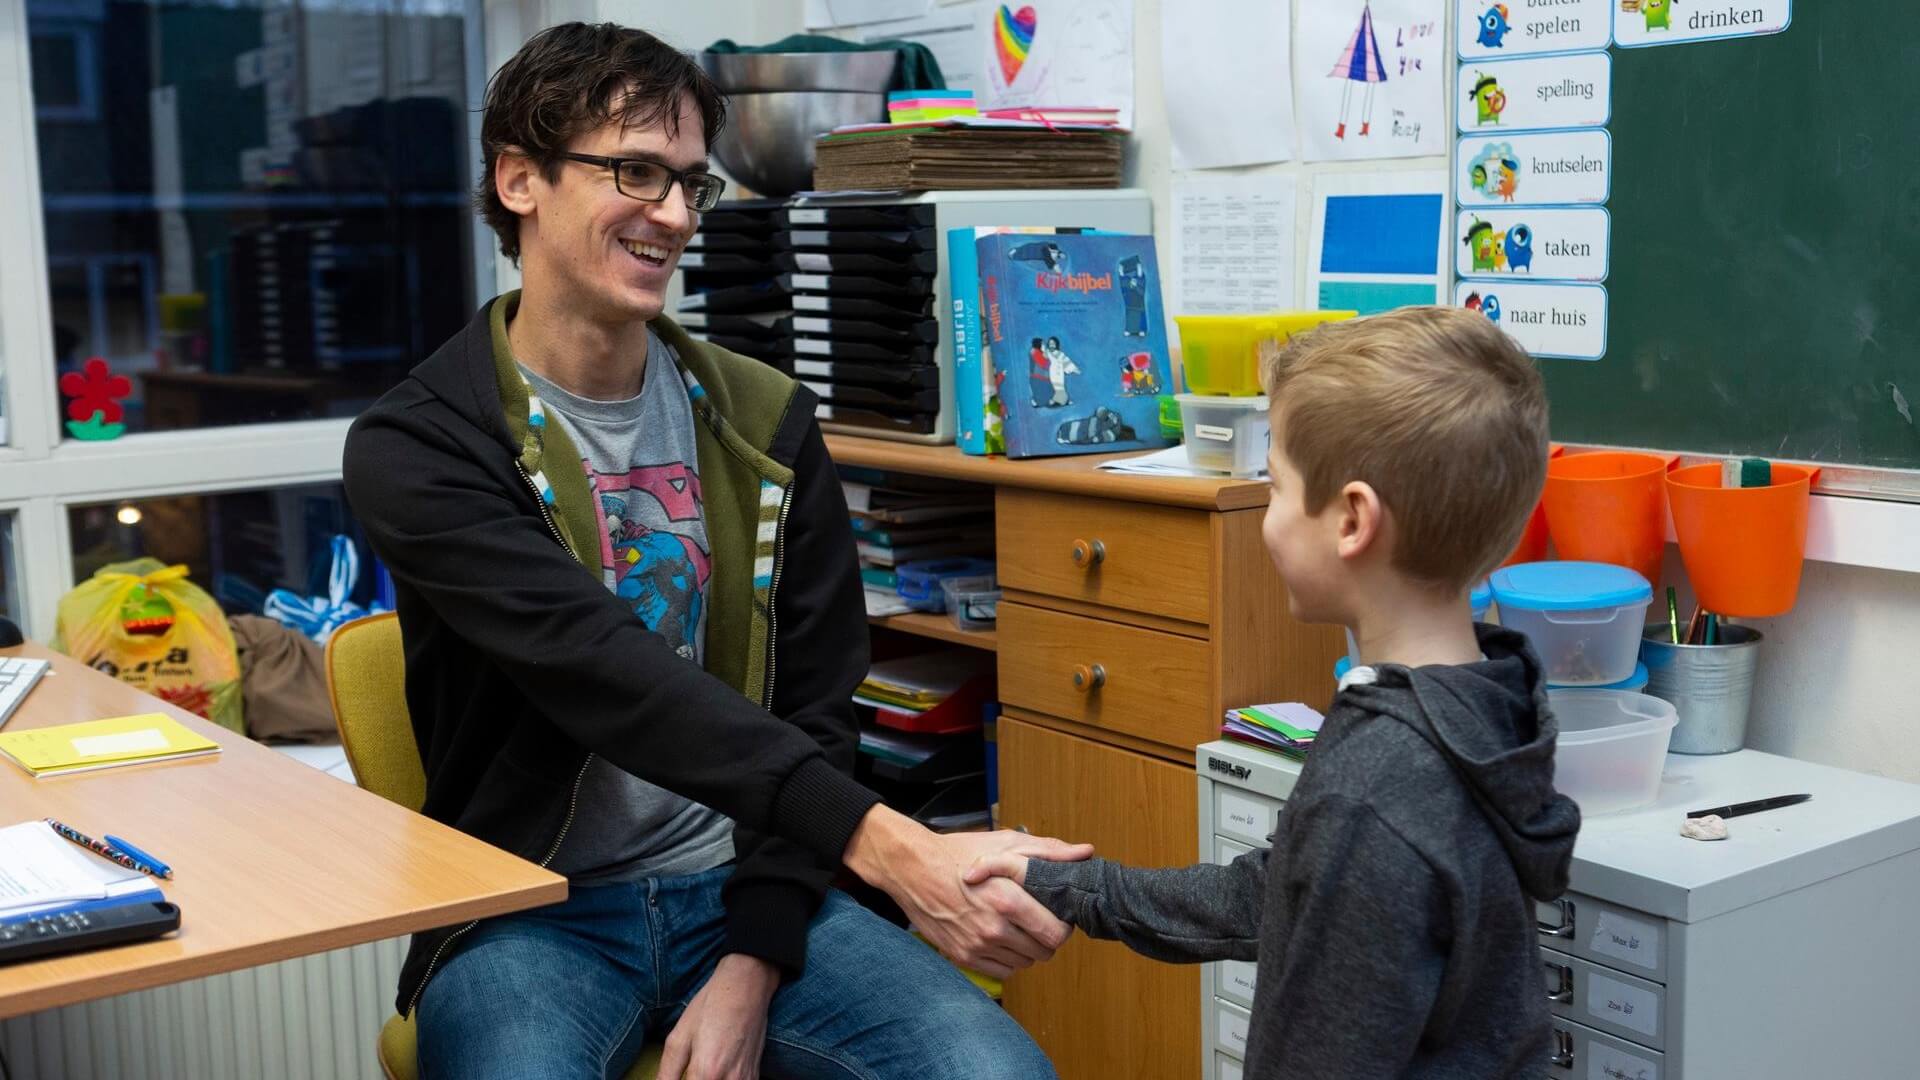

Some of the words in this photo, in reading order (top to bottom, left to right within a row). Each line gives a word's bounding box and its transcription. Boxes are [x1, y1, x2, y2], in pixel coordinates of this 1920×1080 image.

[1526, 16, 1581, 38] spelen
[1688, 7, 1764, 30] drinken
[1537, 79, 1594, 101] spelling
[1532, 155, 1603, 174] knutselen
[1545, 240, 1591, 256] taken
[1036, 272, 1112, 295] Kijkbijbel
[1510, 309, 1546, 324] naar
[1552, 308, 1587, 326] huis
[953, 299, 966, 368] BIJBEL
[1208, 756, 1252, 780] BISLEY
